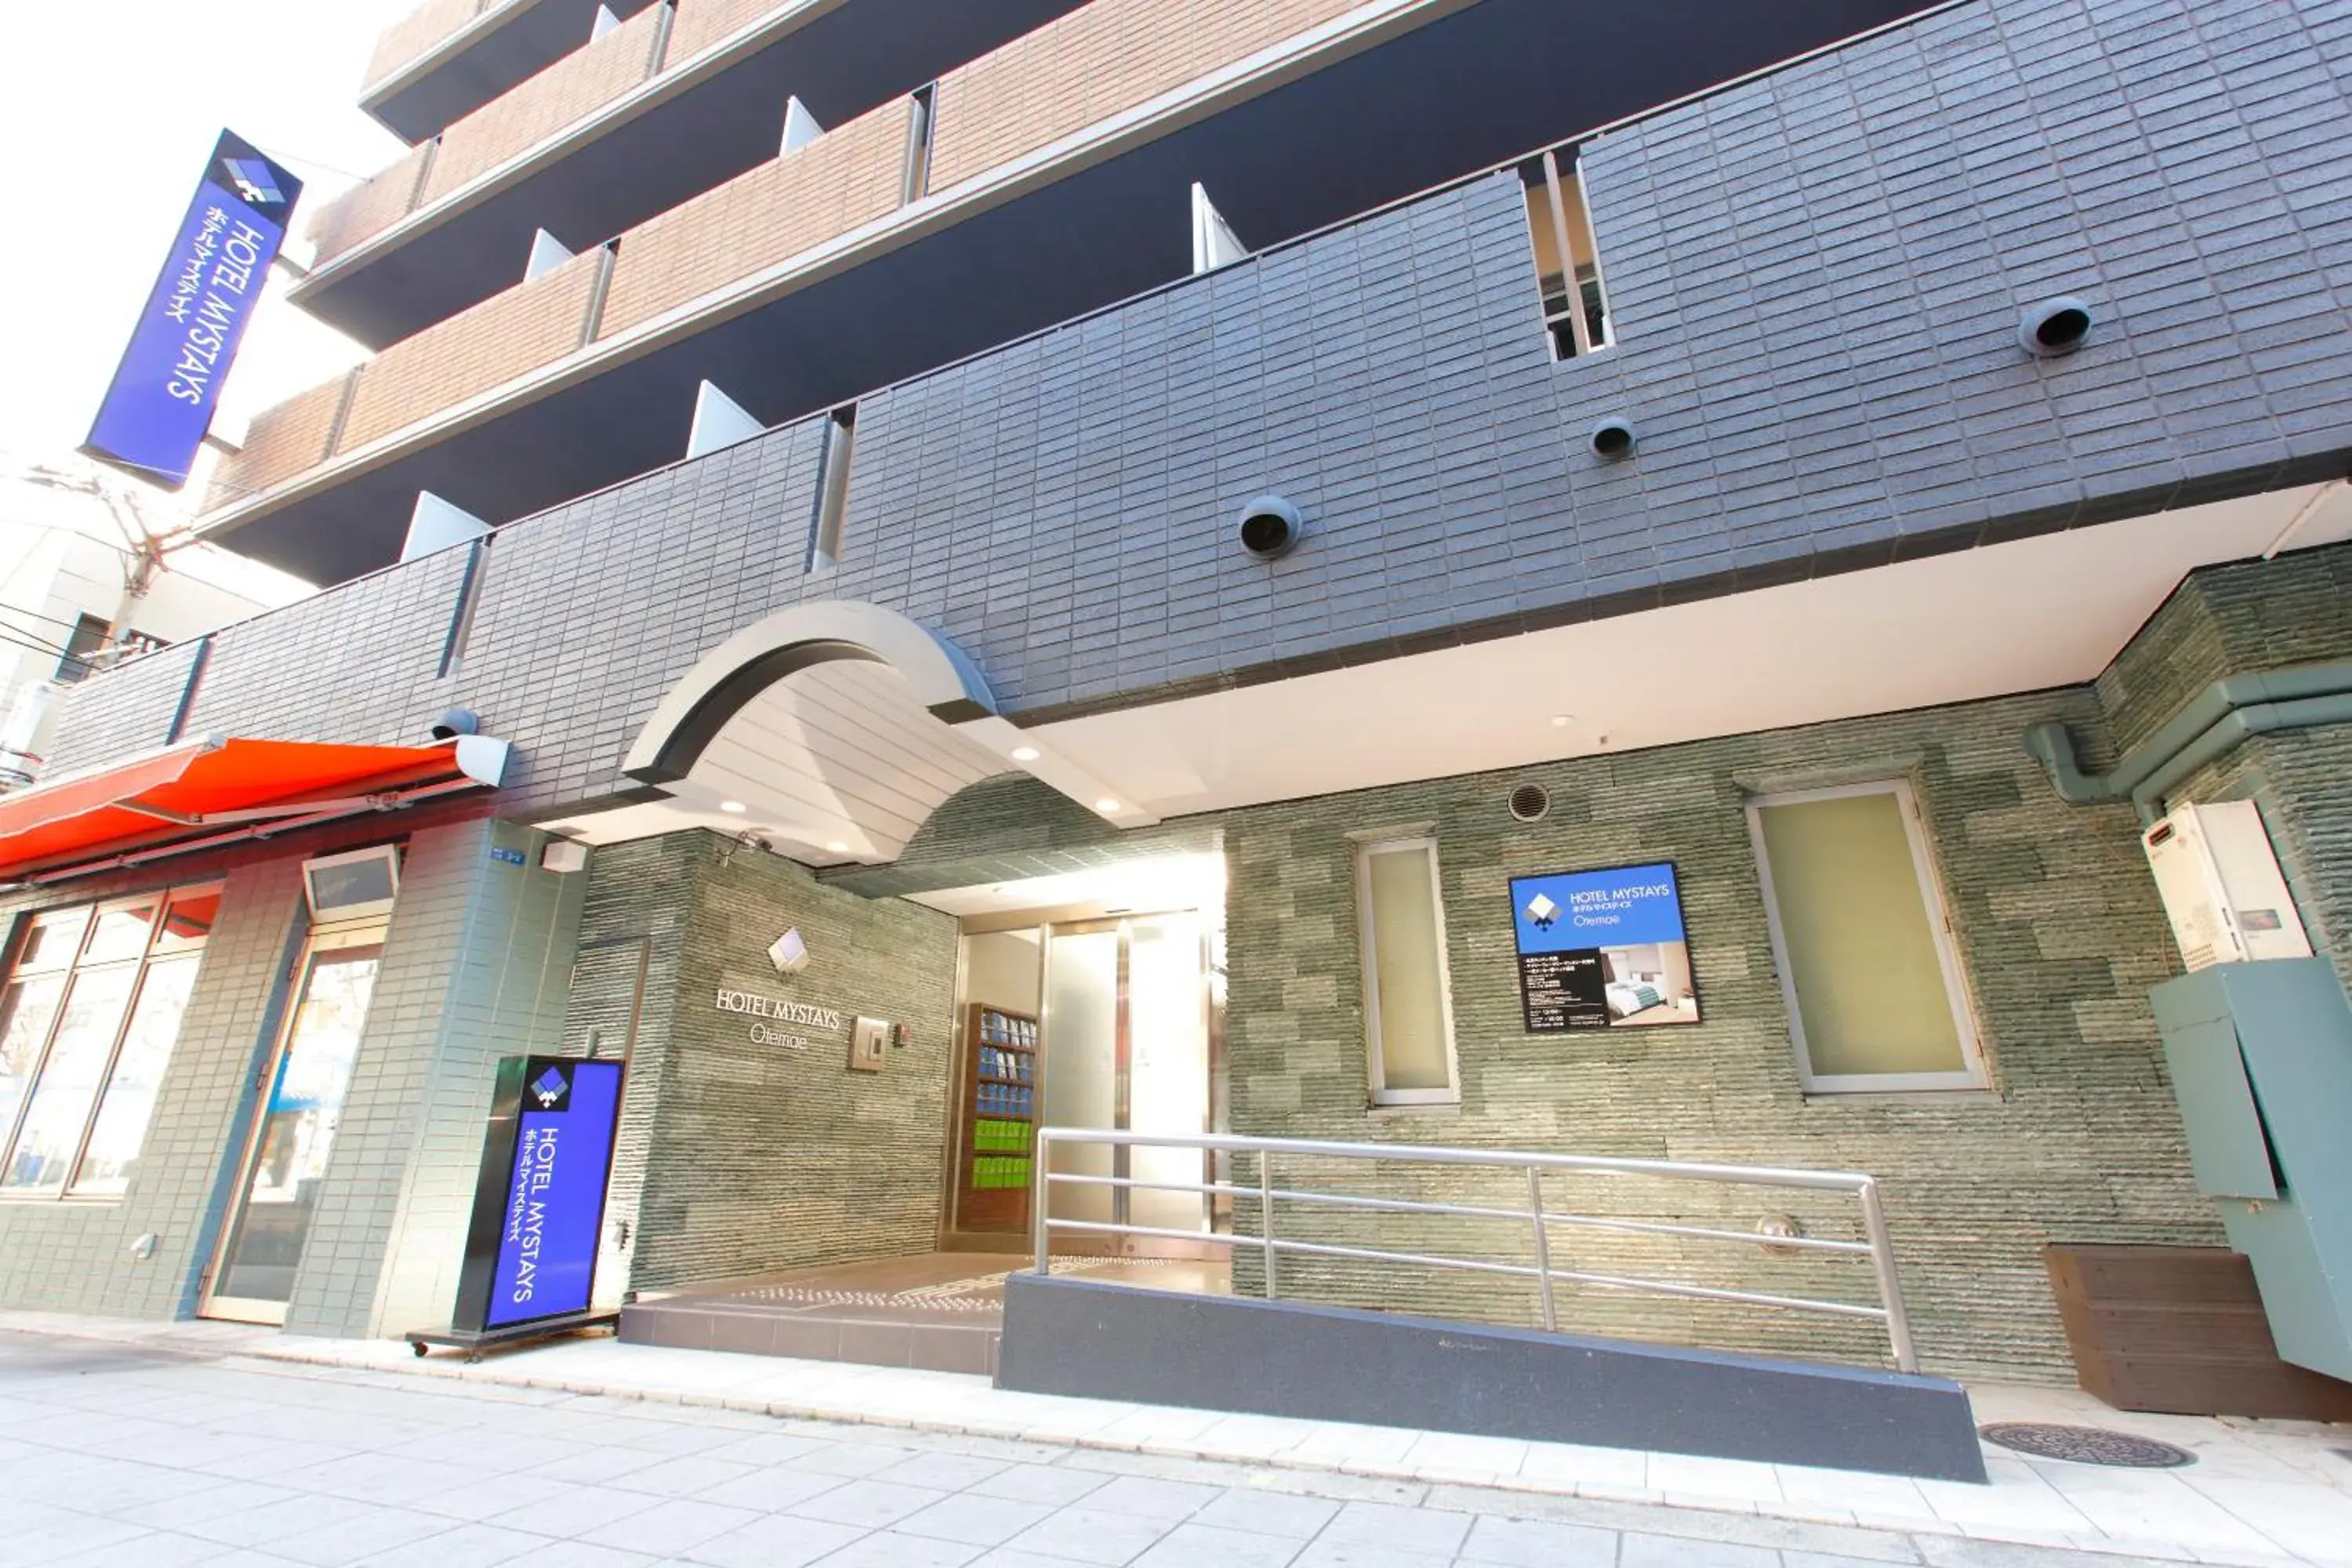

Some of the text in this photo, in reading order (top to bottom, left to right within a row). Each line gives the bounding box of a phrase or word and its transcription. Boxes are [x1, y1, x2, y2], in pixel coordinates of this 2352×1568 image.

[166, 220, 264, 405] HOTEL MYSTAYS
[1570, 884, 1670, 904] HOTEL MYSTAYS
[716, 988, 841, 1029] HOTEL MYSTAYS
[750, 1023, 808, 1050] Otemae
[513, 1127, 559, 1304] HOTEL MYSTAYS
